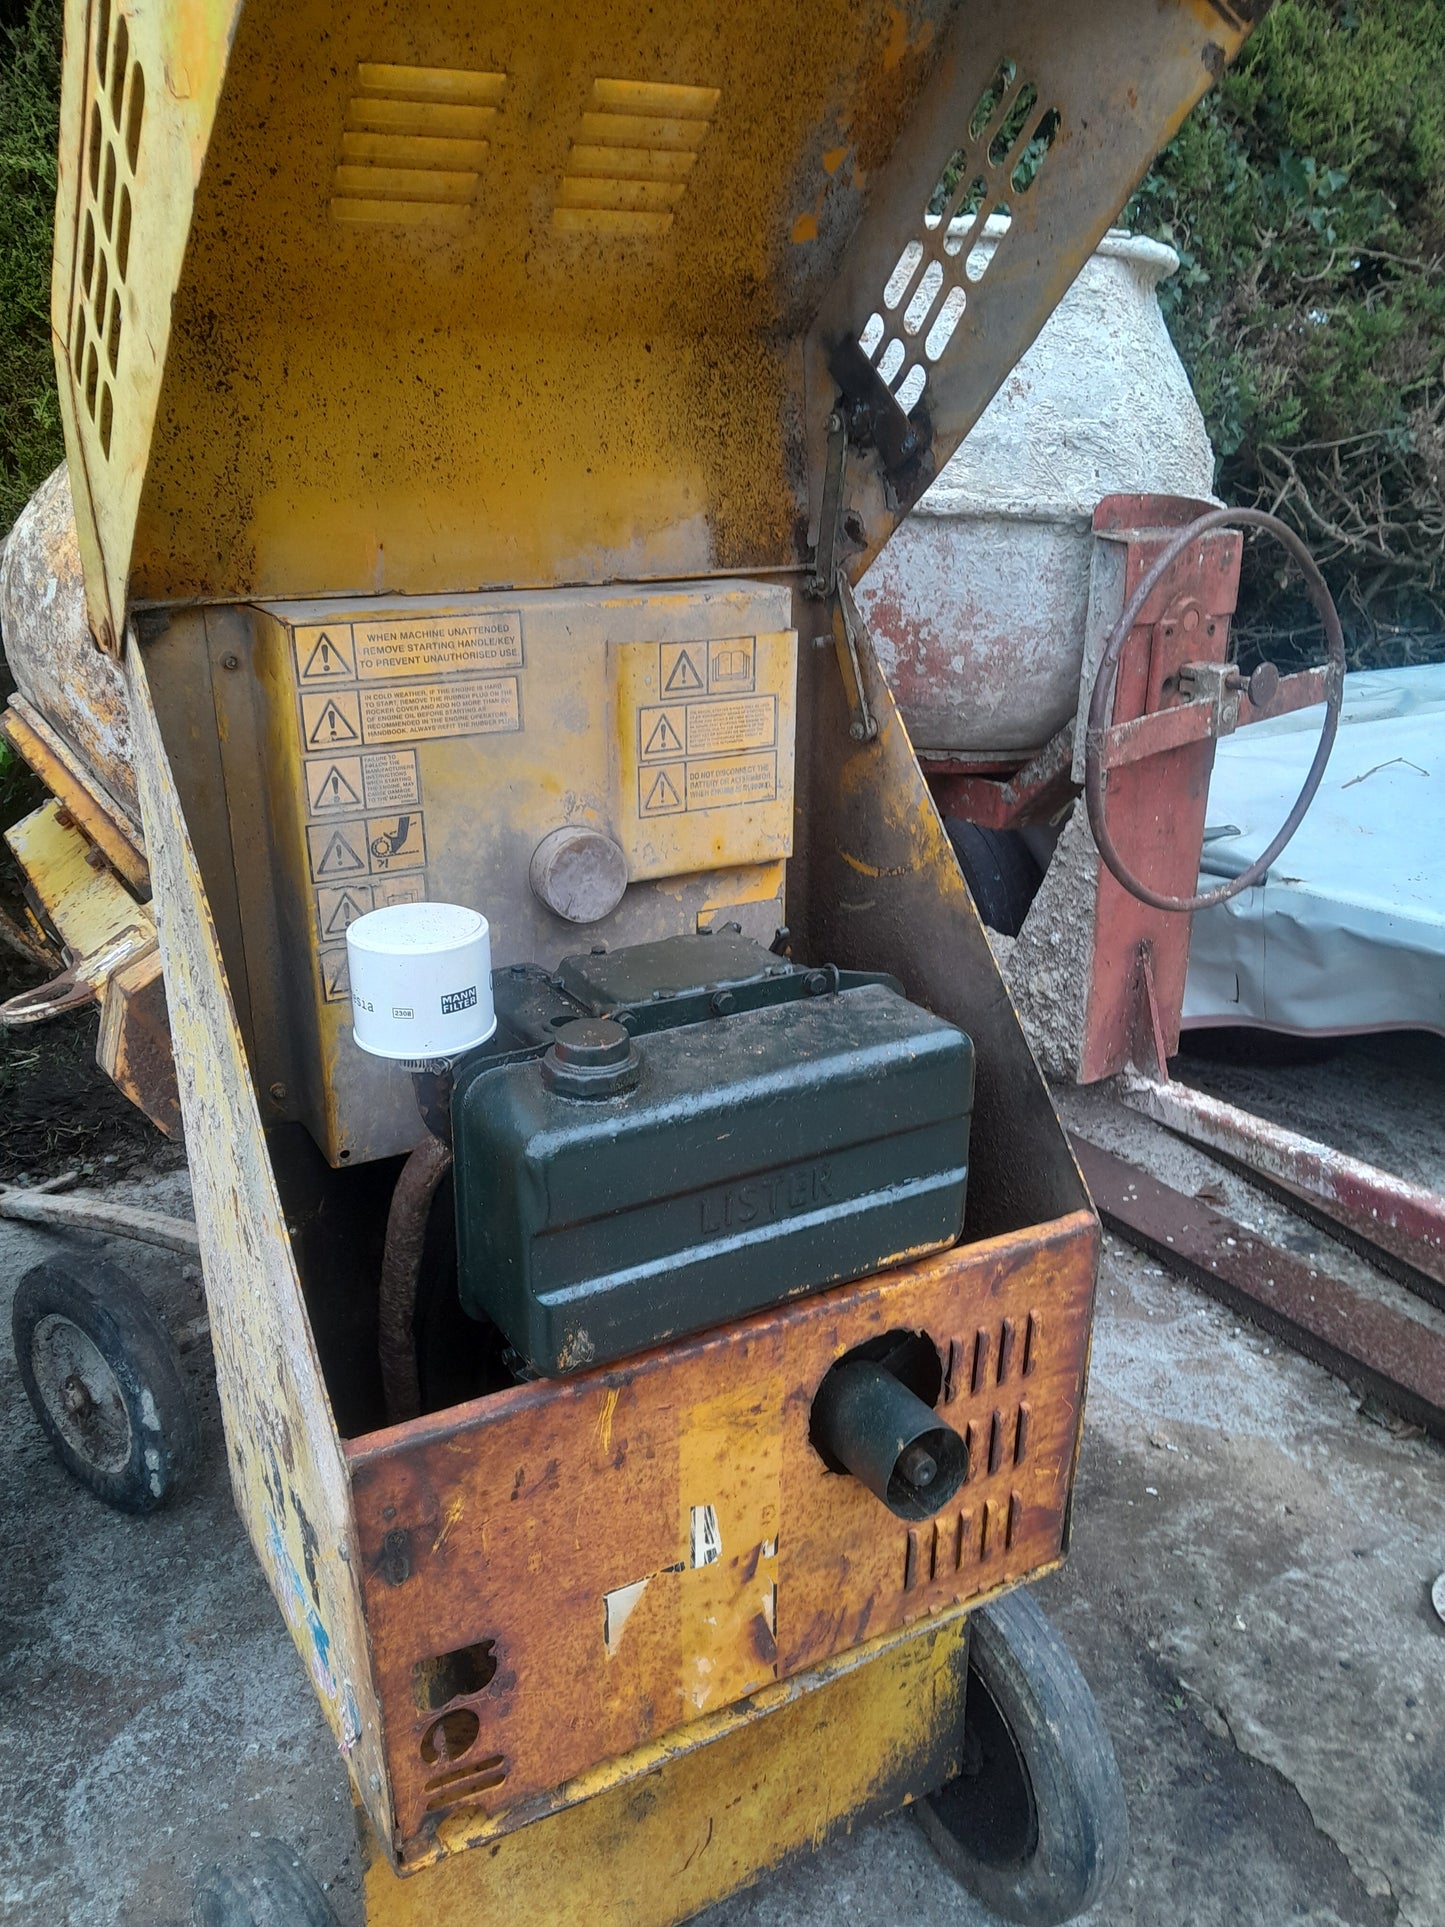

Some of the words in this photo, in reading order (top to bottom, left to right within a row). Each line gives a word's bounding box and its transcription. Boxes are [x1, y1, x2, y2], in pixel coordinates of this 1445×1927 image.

[367, 632, 397, 642] WHEN
[400, 629, 445, 641] MACHINE
[447, 624, 510, 637] UNATTENDED
[363, 644, 405, 655] REMOVE
[407, 640, 455, 653] STARTING
[457, 636, 515, 648] HANDLE/KEY
[360, 660, 373, 668] TO
[376, 656, 421, 667] PREVENT
[423, 650, 497, 664] UNAUTHORISED
[500, 648, 517, 657] USE
[400, 698, 428, 706] REMOVE
[443, 693, 470, 701] RUBBER
[396, 705, 419, 713] COVER
[417, 709, 444, 718] BEFORE
[445, 707, 476, 715] STARTING
[367, 720, 420, 729] RECOMMENDED
[409, 725, 436, 733] ALWAYS
[701, 770, 714, 779] NOT
[715, 765, 756, 777] DISCONNECT
[442, 988, 476, 1004] MANN
[443, 997, 476, 1013] FILTER
[700, 1161, 833, 1235] LISTER
